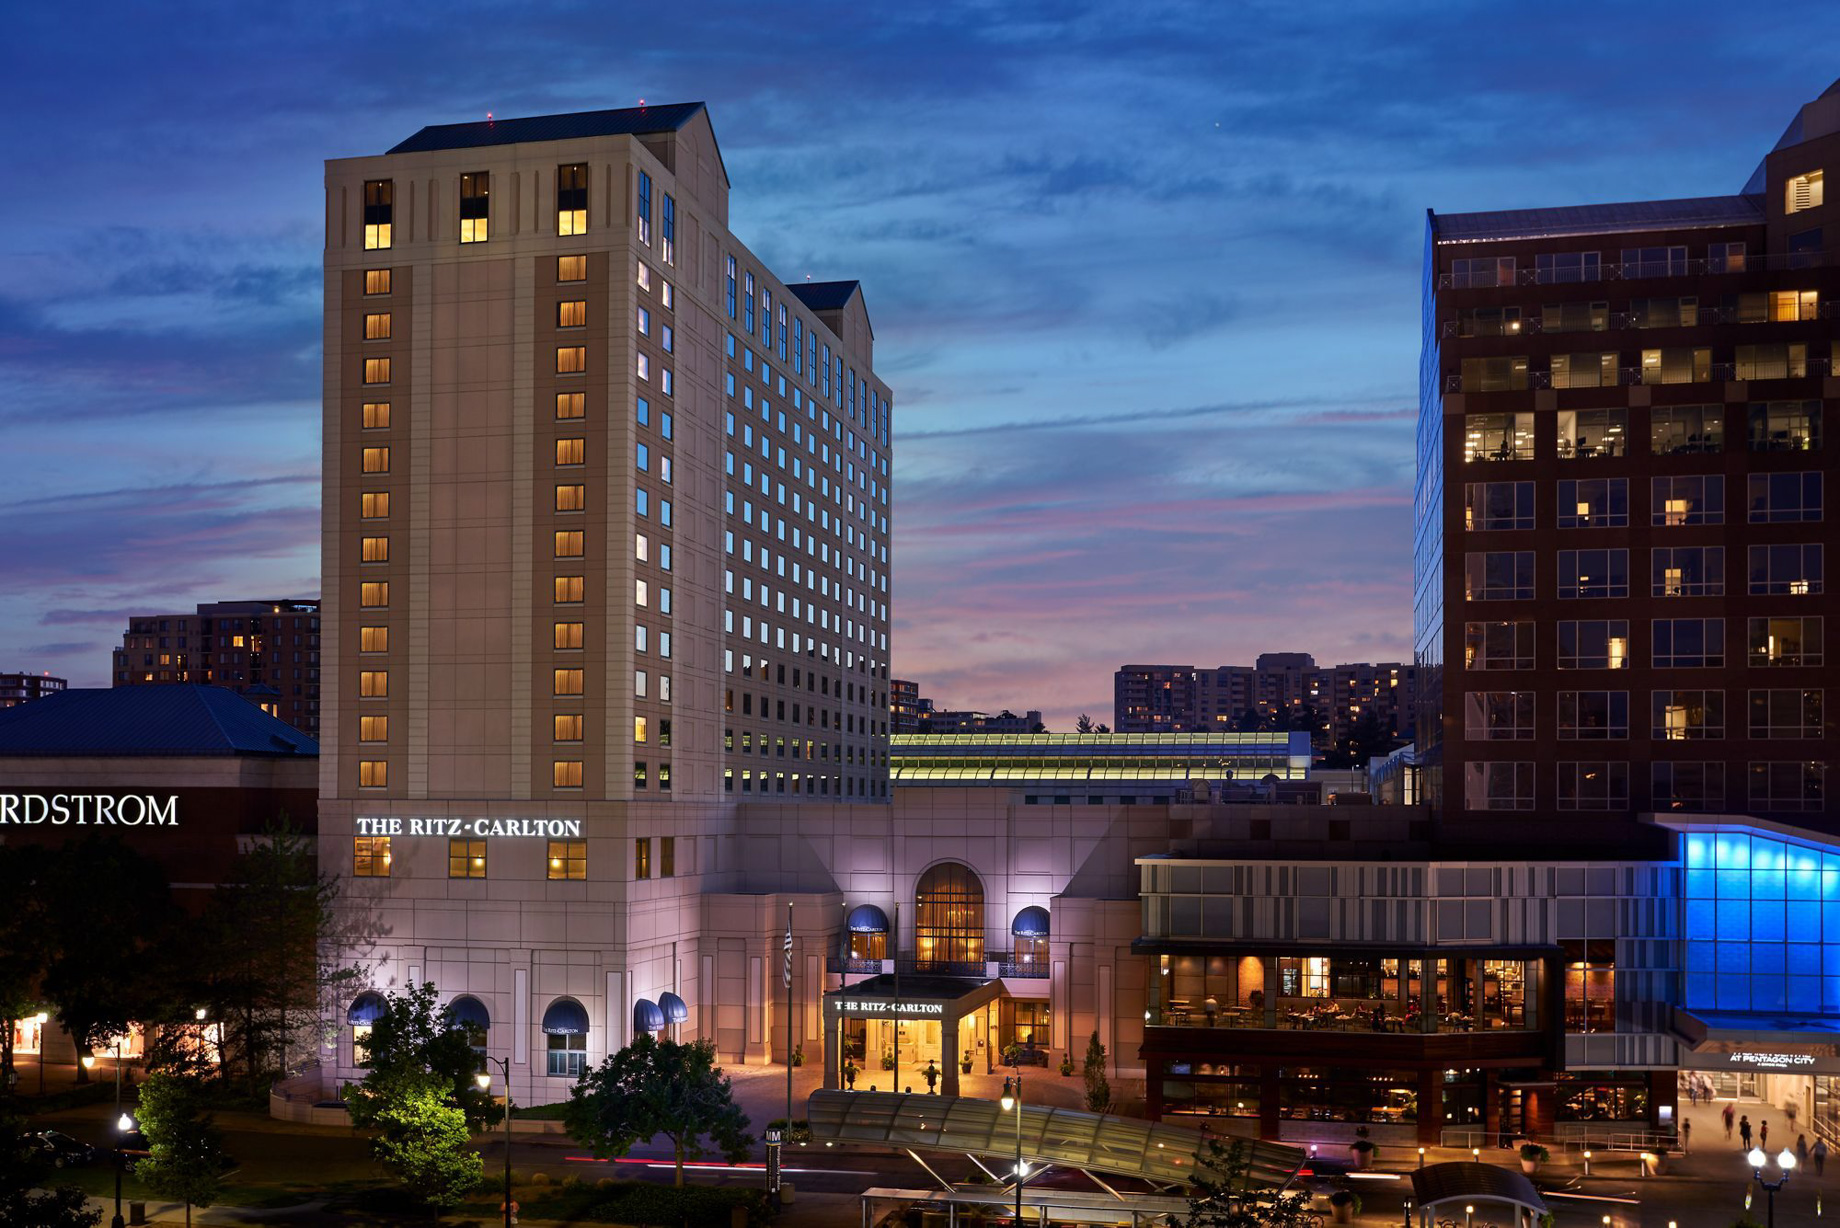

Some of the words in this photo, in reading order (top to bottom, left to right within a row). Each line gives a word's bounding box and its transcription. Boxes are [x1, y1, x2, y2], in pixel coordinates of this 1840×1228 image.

[0, 794, 179, 826] RDSTROM
[356, 818, 402, 835] THE
[835, 1001, 858, 1010] THE
[1742, 1055, 1793, 1064] PENTAGON
[1794, 1057, 1815, 1065] CITY
